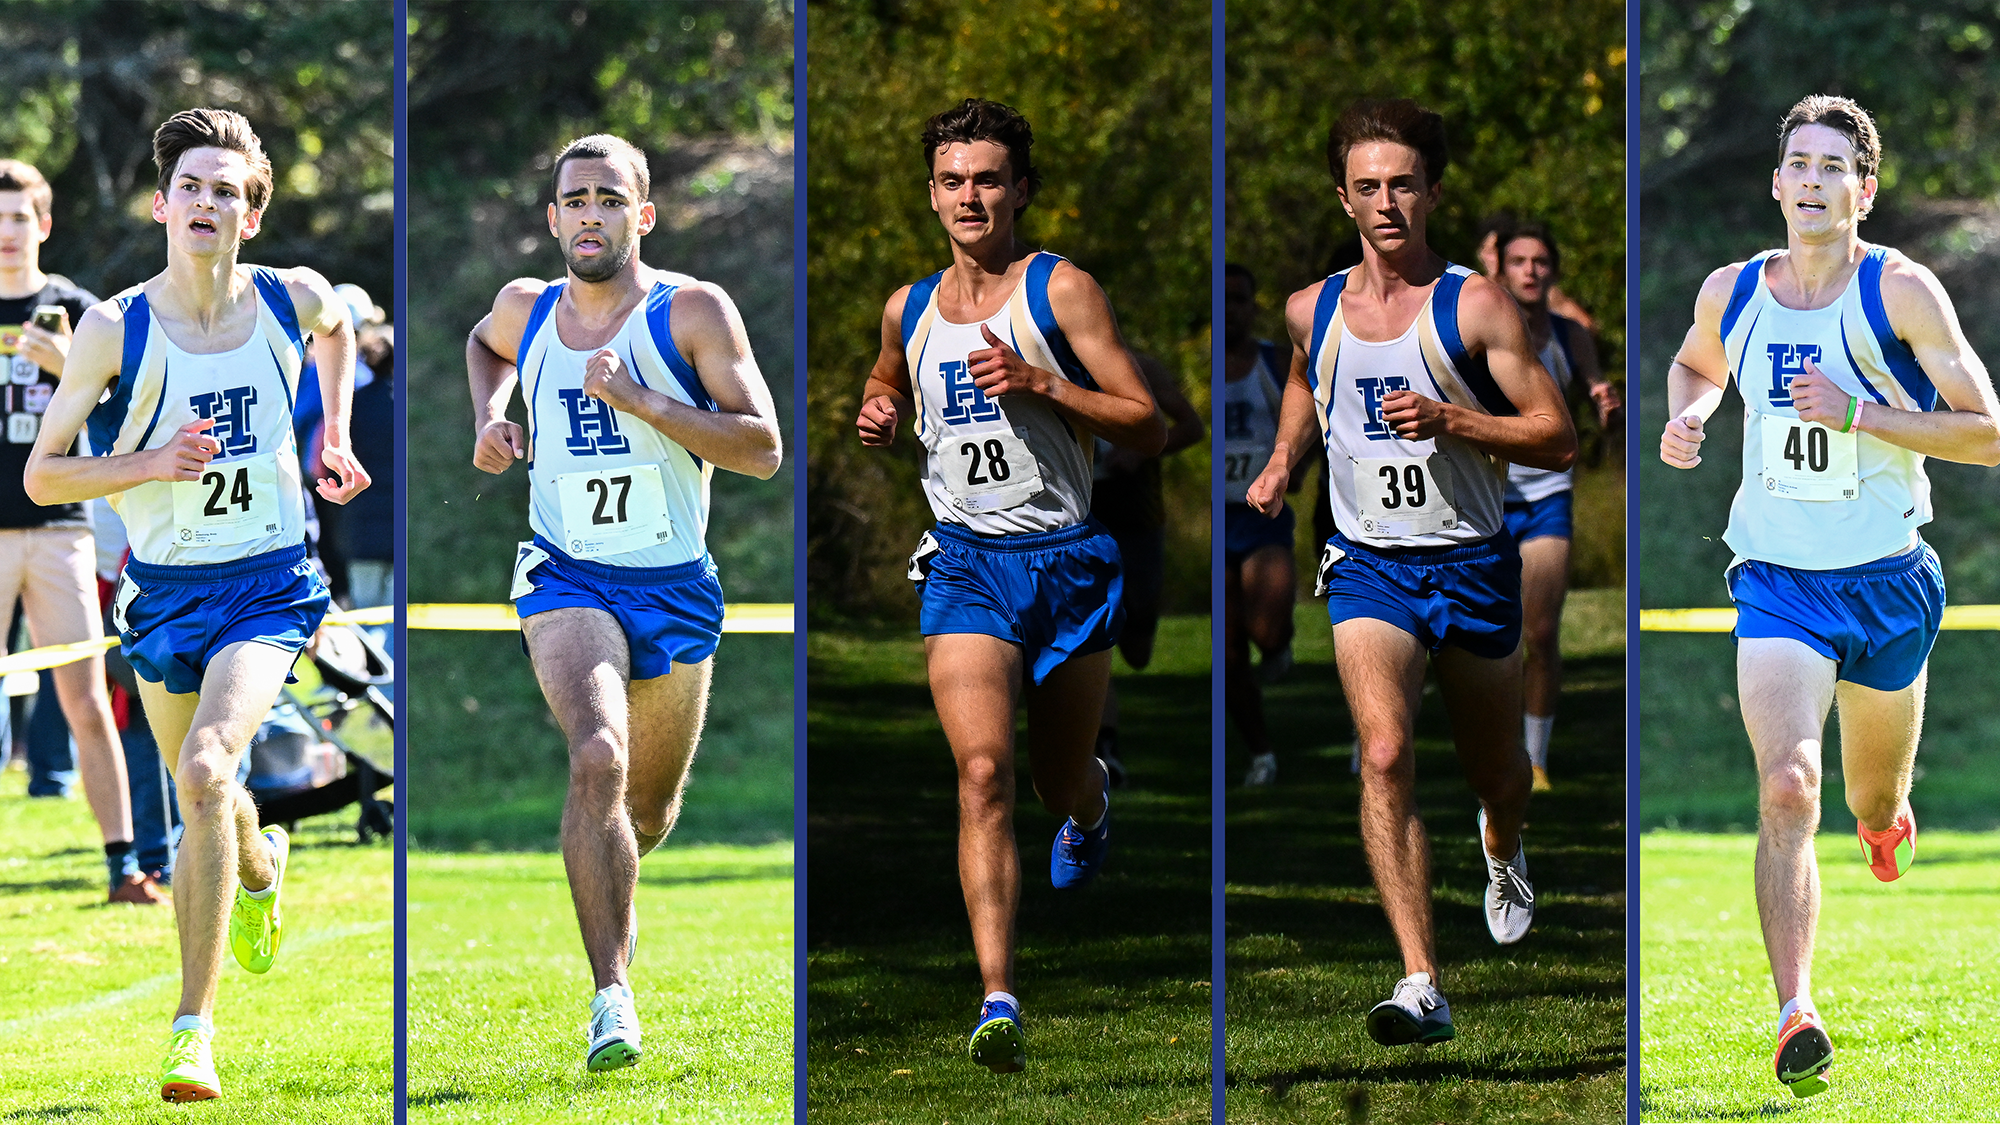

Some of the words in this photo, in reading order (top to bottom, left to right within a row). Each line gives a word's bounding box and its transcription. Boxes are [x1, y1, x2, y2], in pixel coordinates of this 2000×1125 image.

[939, 360, 1002, 426] H
[1767, 343, 1822, 408] H
[189, 385, 258, 460] H
[558, 388, 631, 457] H
[1356, 376, 1411, 442] H
[960, 438, 1011, 486] 28
[1225, 453, 1251, 481] 27
[1783, 426, 1829, 472] 40
[202, 467, 253, 517] 24
[586, 475, 632, 525] 27
[1378, 464, 1427, 509] 39
